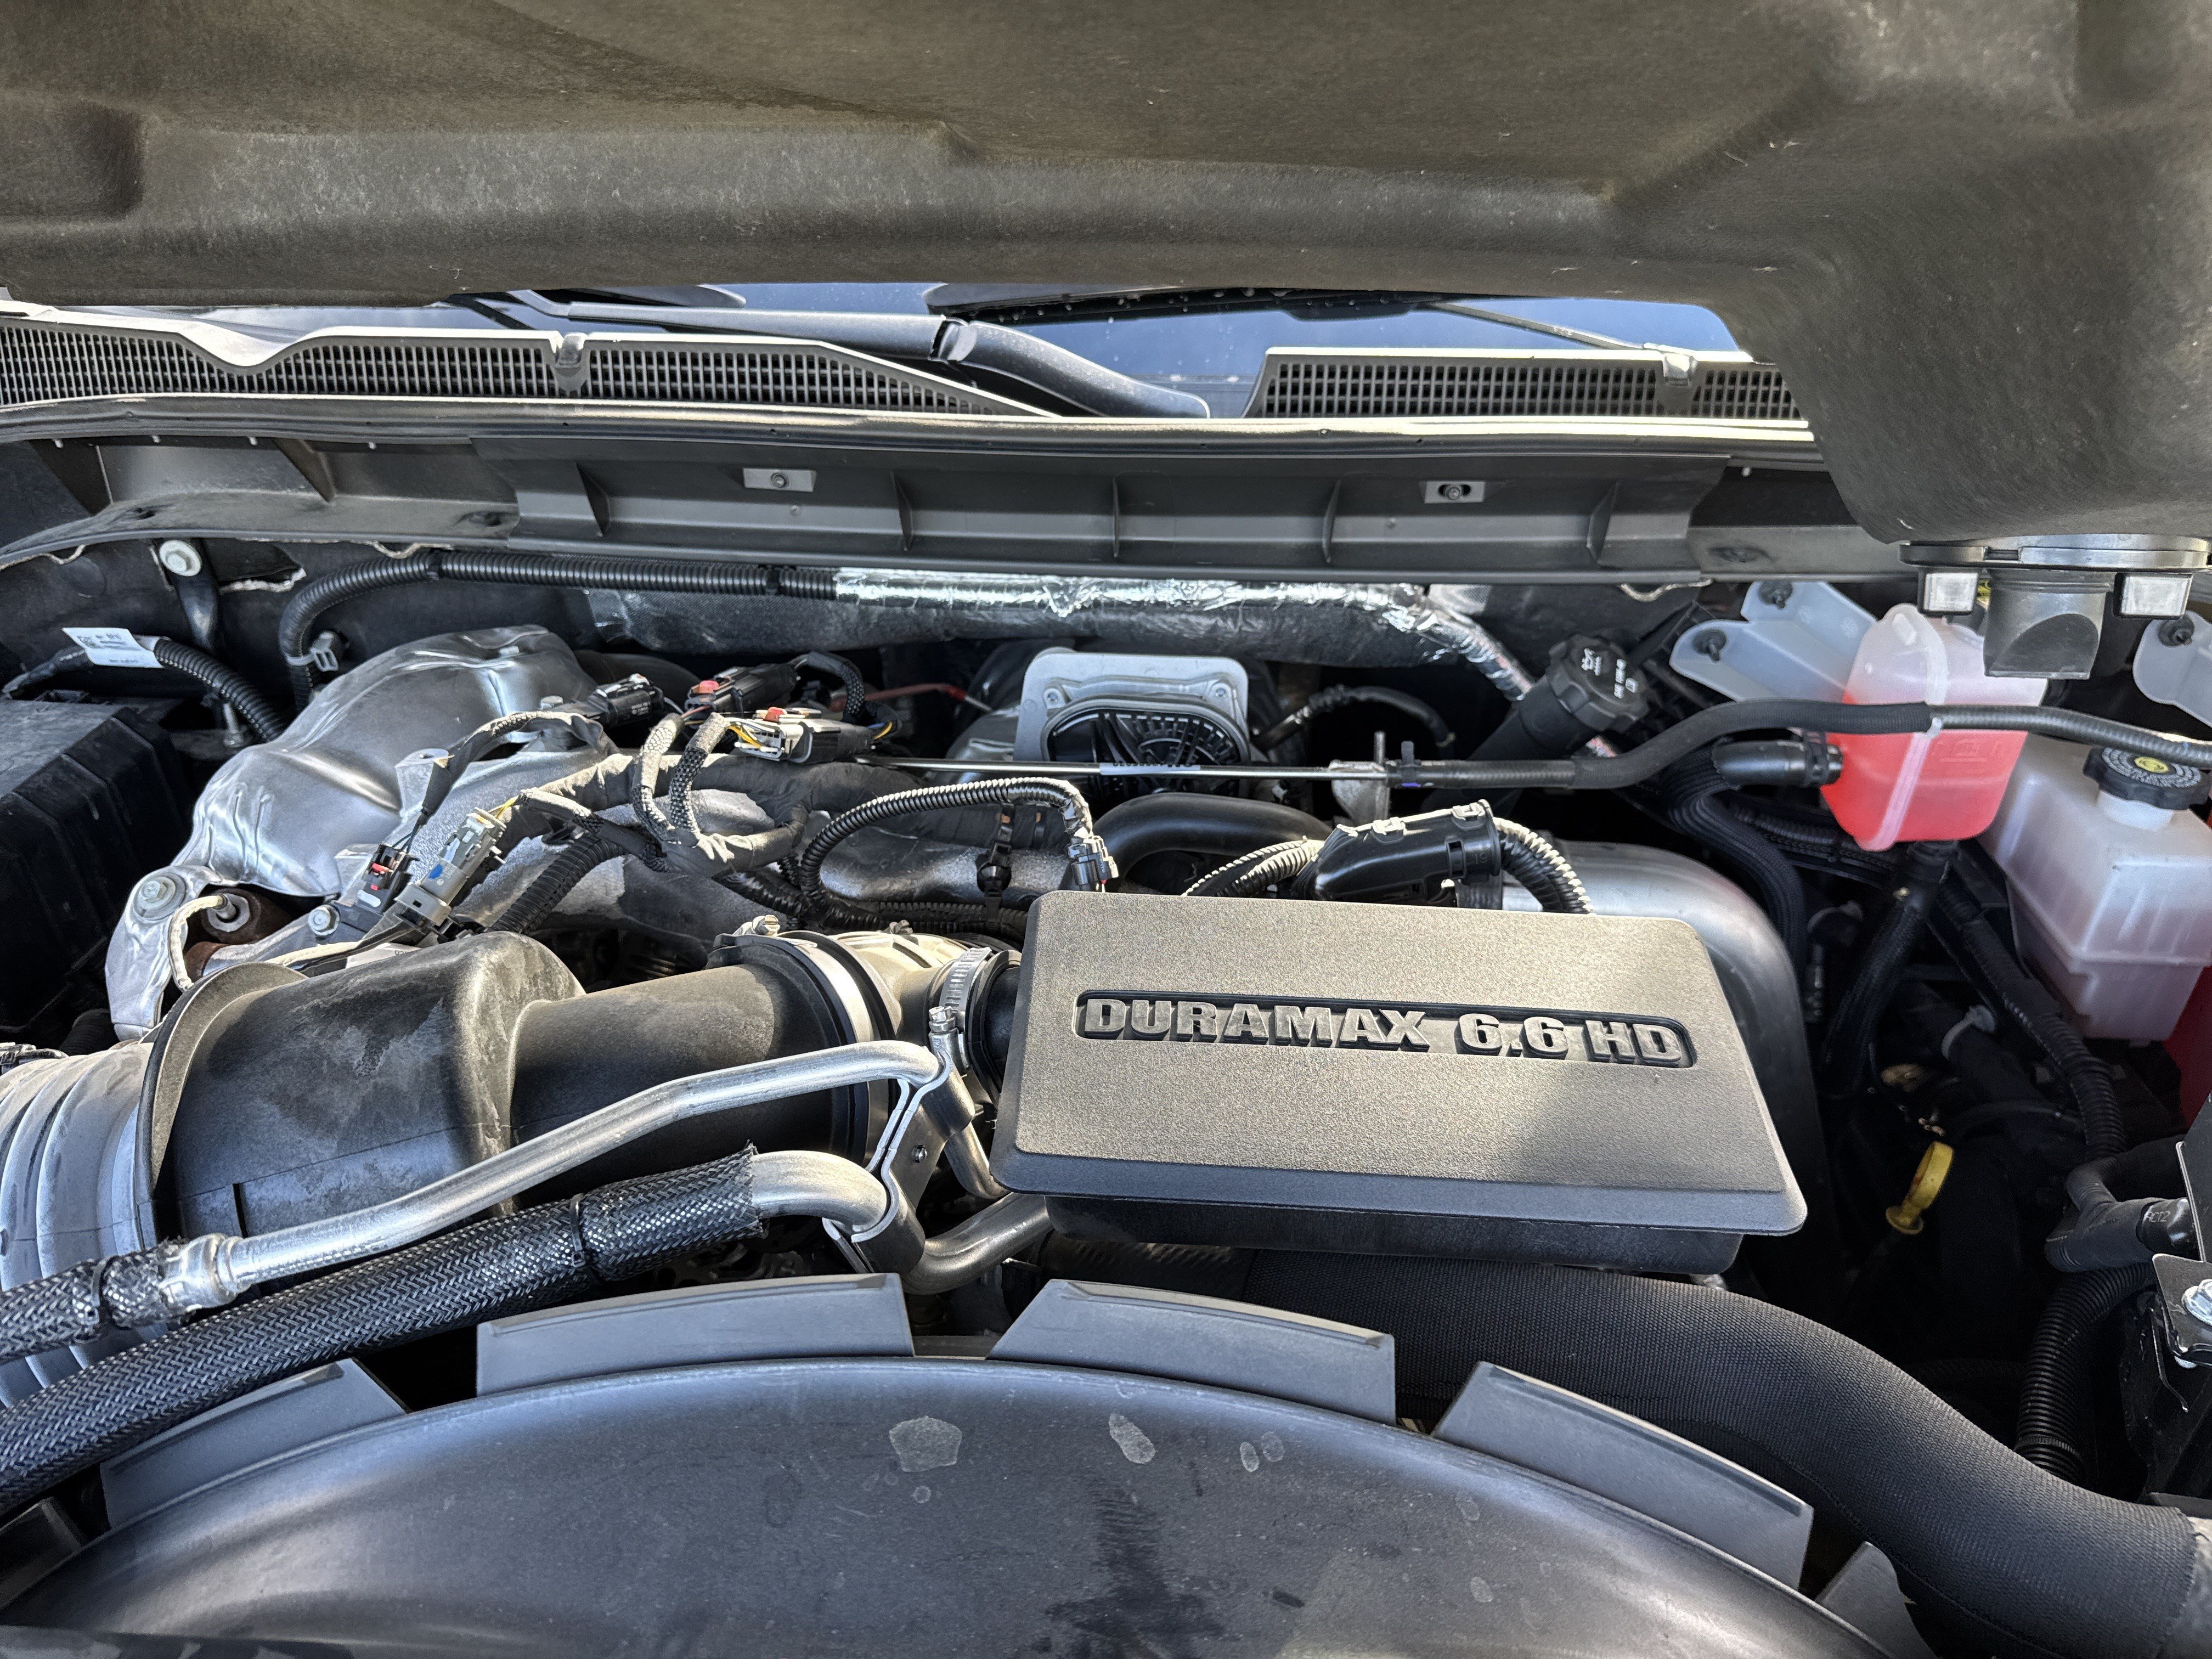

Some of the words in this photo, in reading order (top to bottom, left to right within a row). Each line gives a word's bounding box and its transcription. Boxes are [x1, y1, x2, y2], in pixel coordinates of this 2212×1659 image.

[1084, 998, 1430, 1050] DURAMAX
[1456, 1013, 1569, 1053] 6.6
[1585, 1019, 1682, 1063] HD
